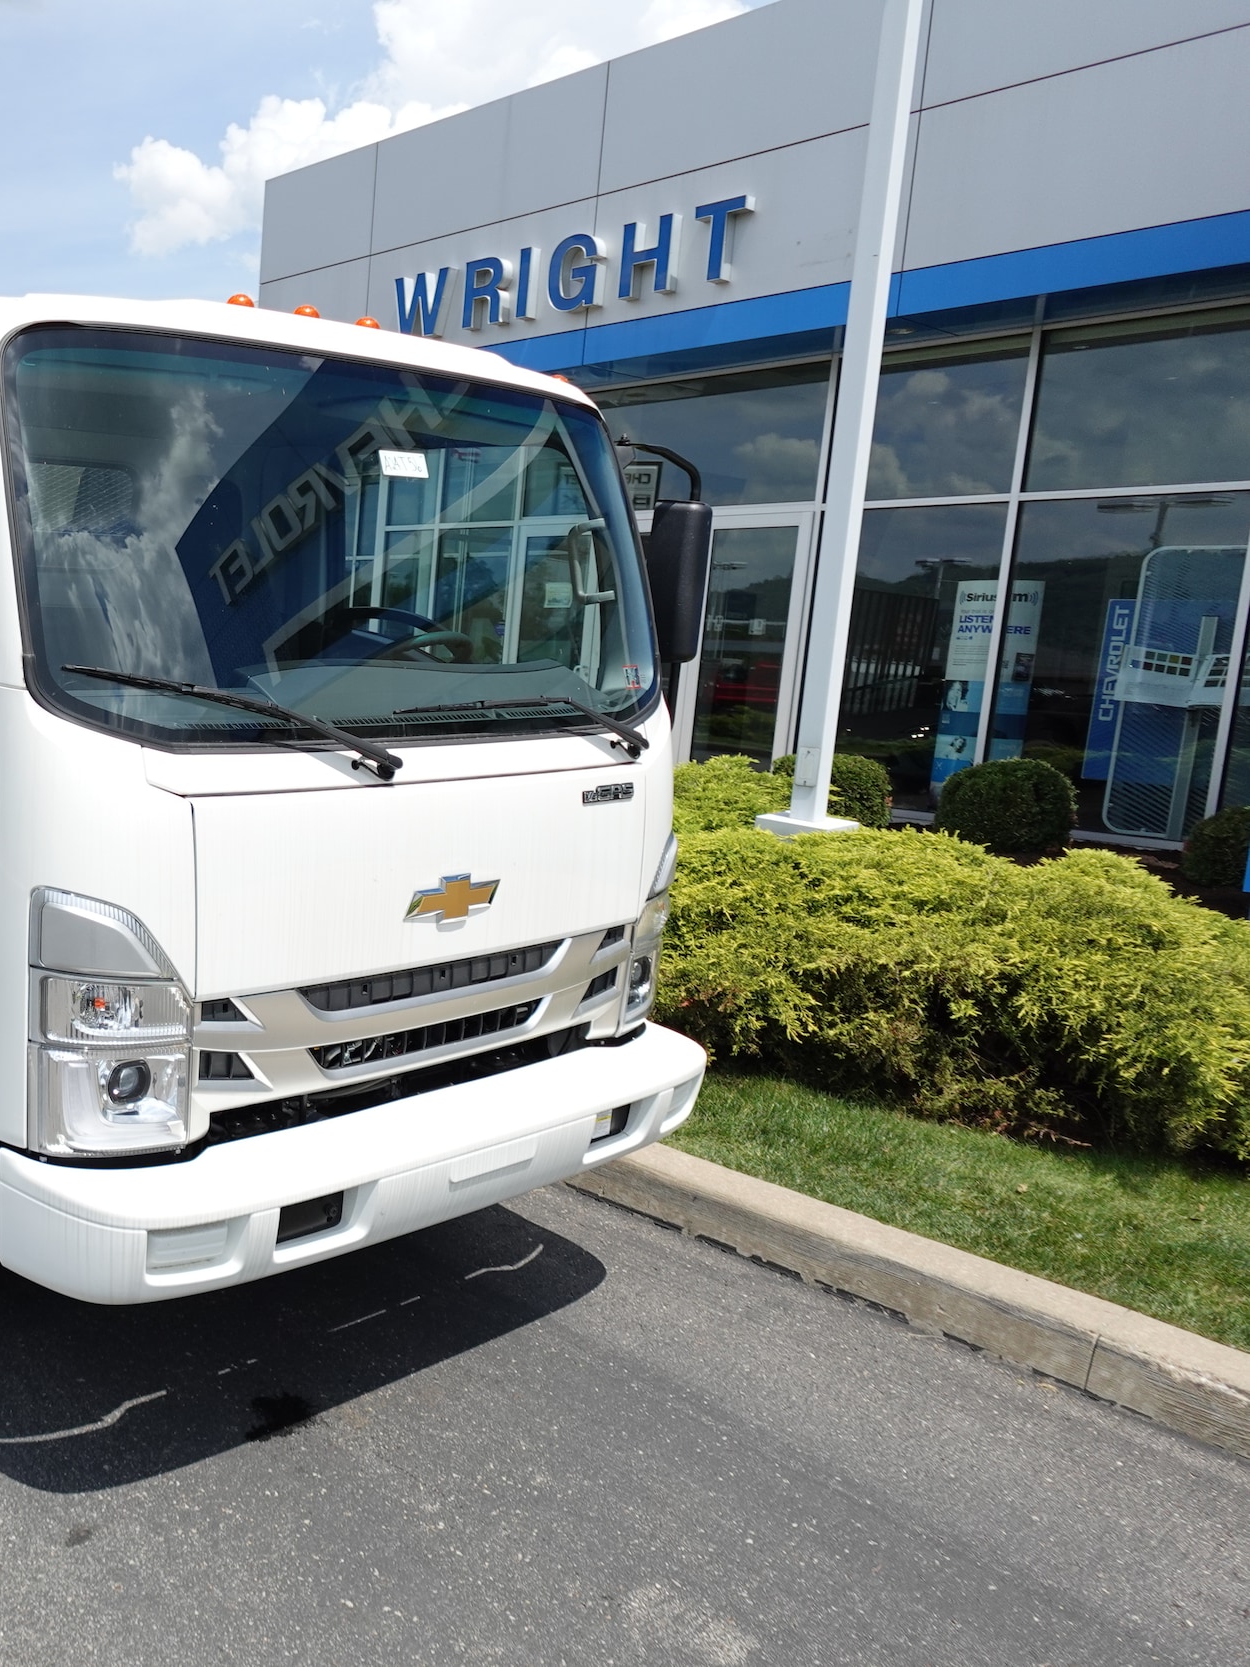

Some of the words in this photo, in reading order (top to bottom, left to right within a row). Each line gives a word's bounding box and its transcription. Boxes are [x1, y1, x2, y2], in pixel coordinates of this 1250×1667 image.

[395, 195, 755, 337] WRIGHT
[958, 625, 1031, 634] ANYWERE
[1098, 605, 1130, 721] CHEVROLET
